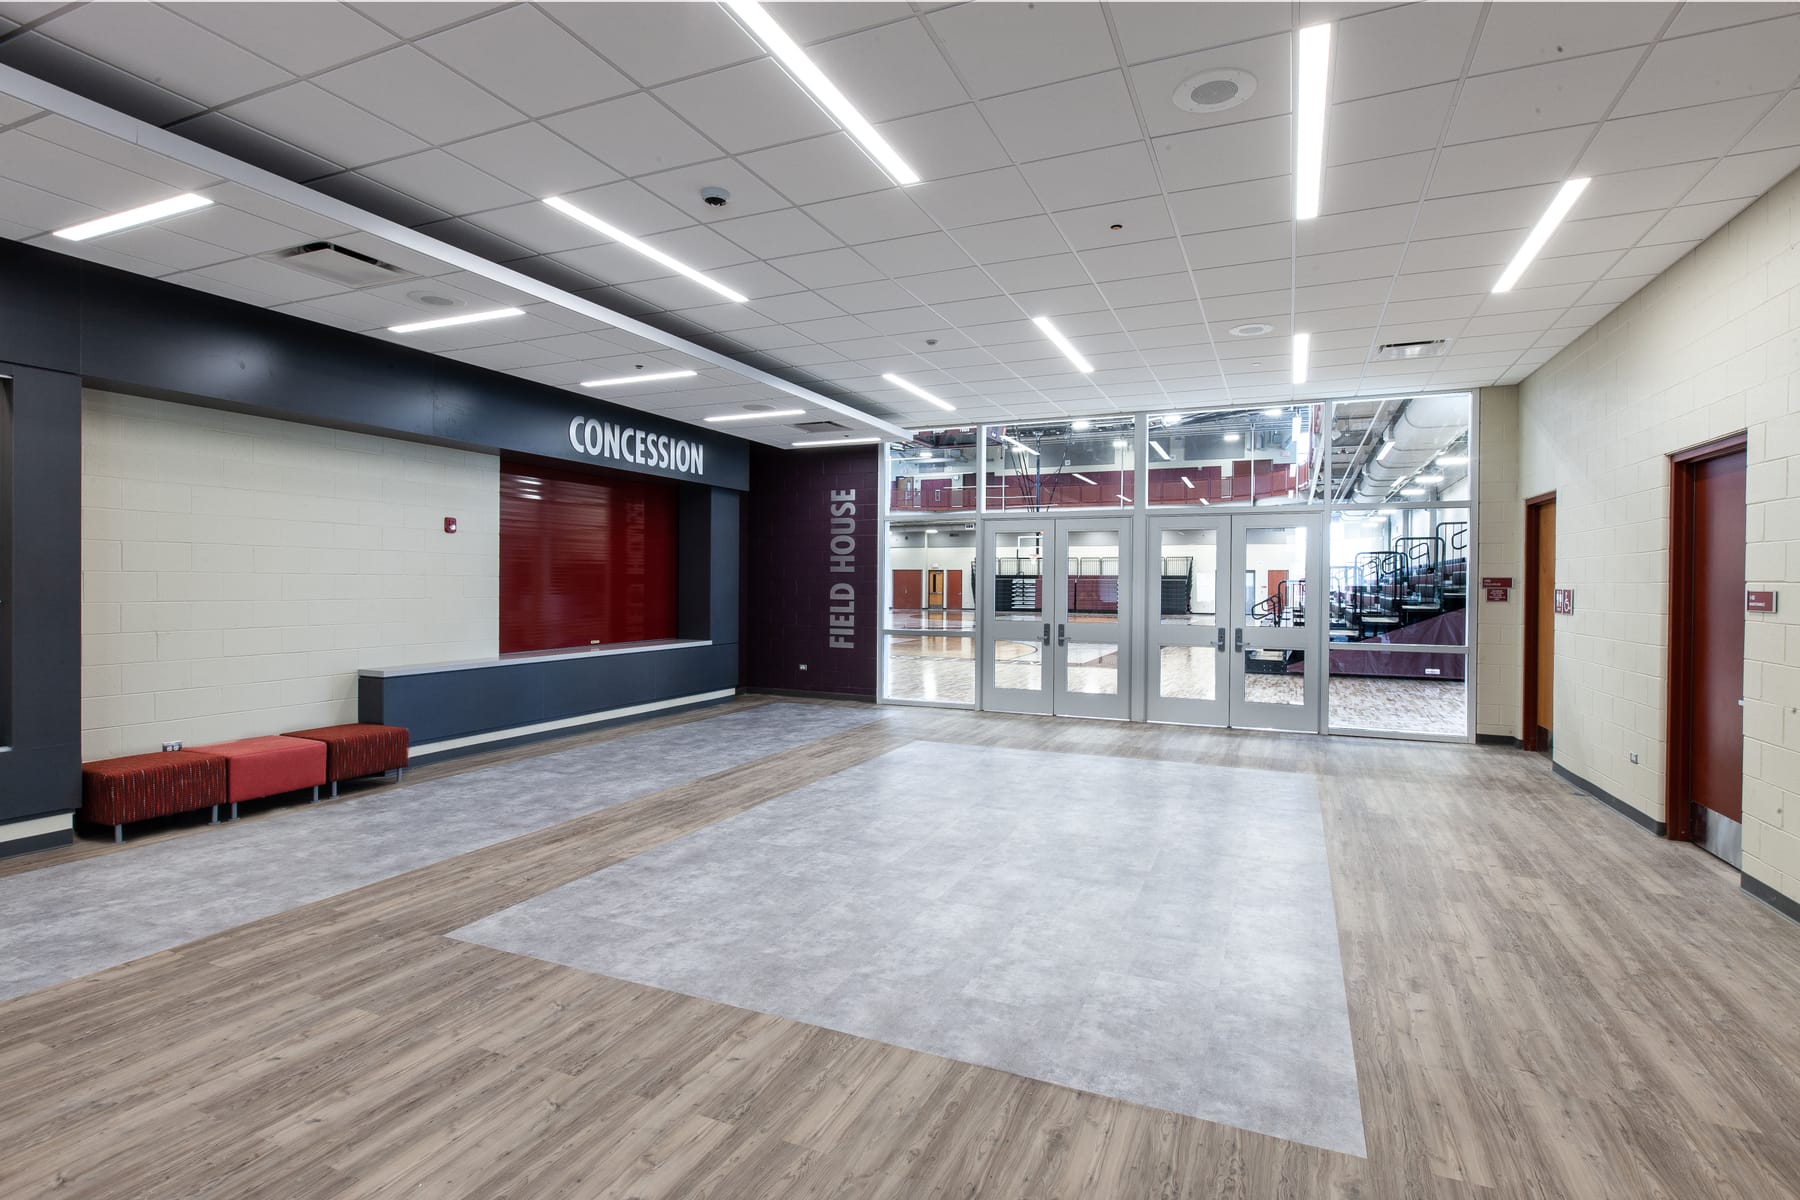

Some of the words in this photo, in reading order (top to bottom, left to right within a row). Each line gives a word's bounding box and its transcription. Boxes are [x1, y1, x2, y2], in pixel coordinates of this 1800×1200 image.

[569, 415, 704, 475] CONCESSION
[829, 489, 856, 573] HOUSE
[829, 583, 855, 649] FIELD
